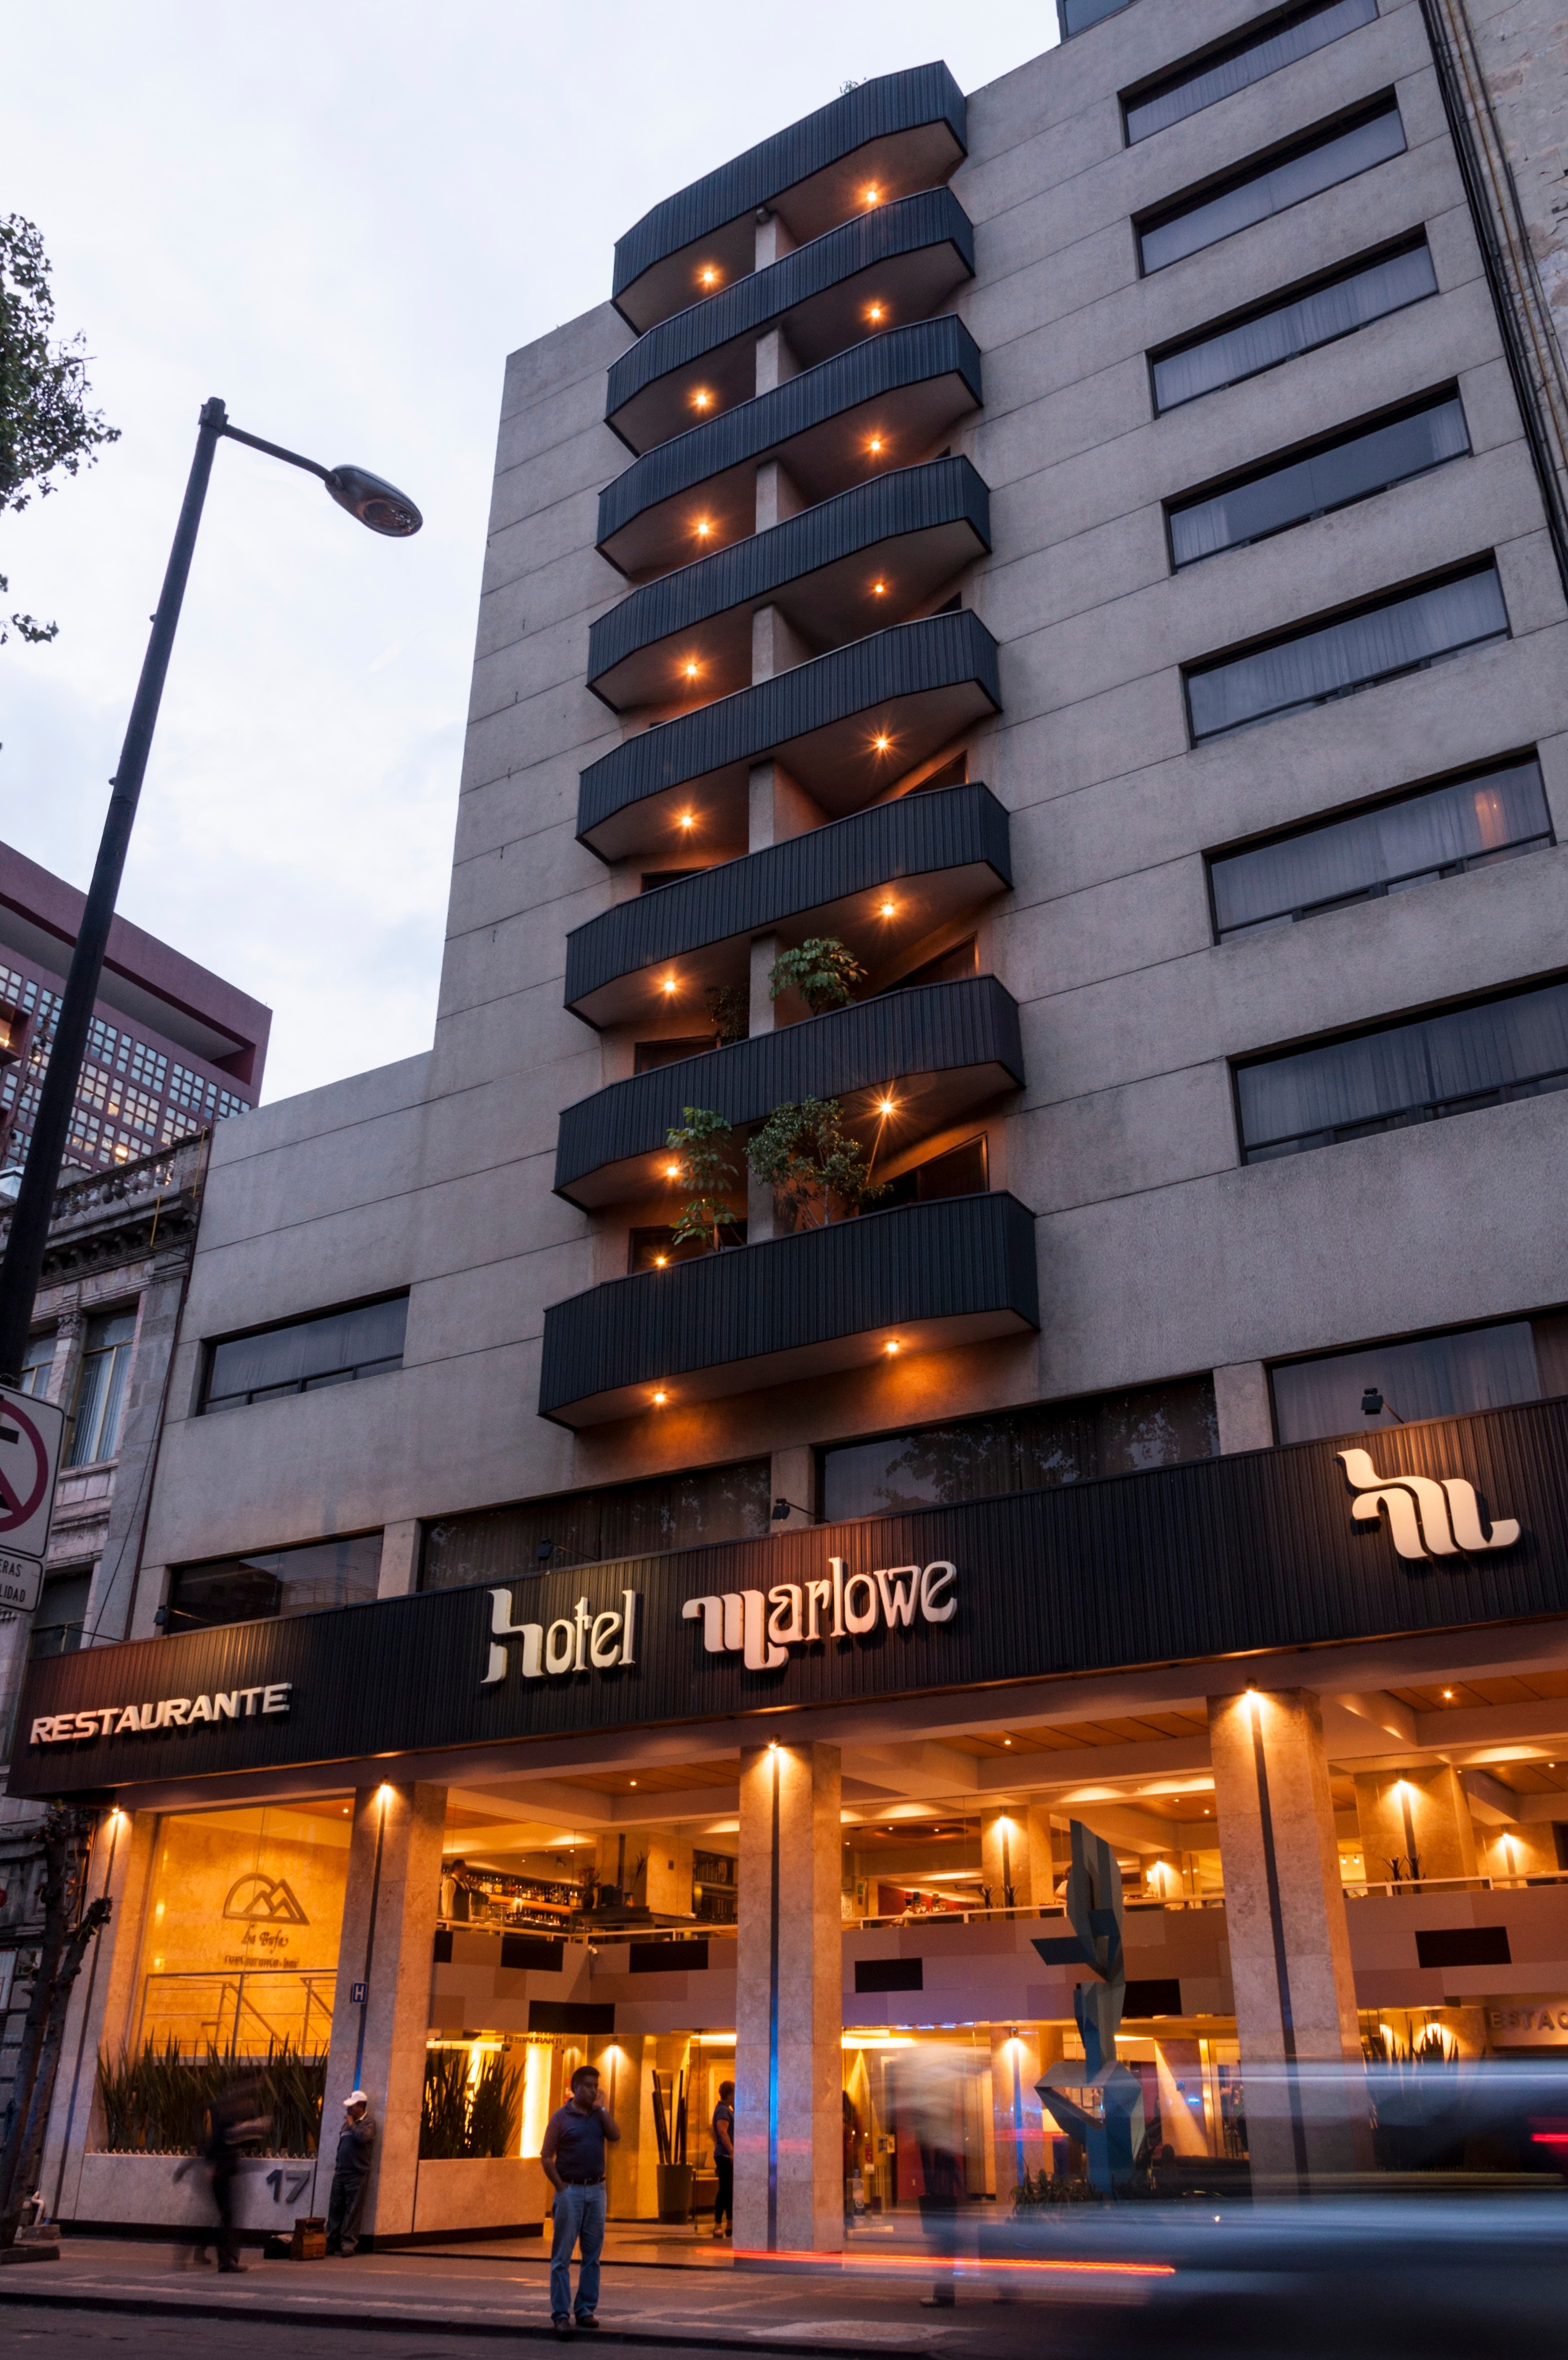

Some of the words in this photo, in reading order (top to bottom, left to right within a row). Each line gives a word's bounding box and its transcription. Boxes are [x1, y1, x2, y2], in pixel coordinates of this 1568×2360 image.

[30, 1682, 292, 1744] RESTAURANTE
[355, 1985, 365, 2001] H
[266, 2168, 310, 2203] 17
